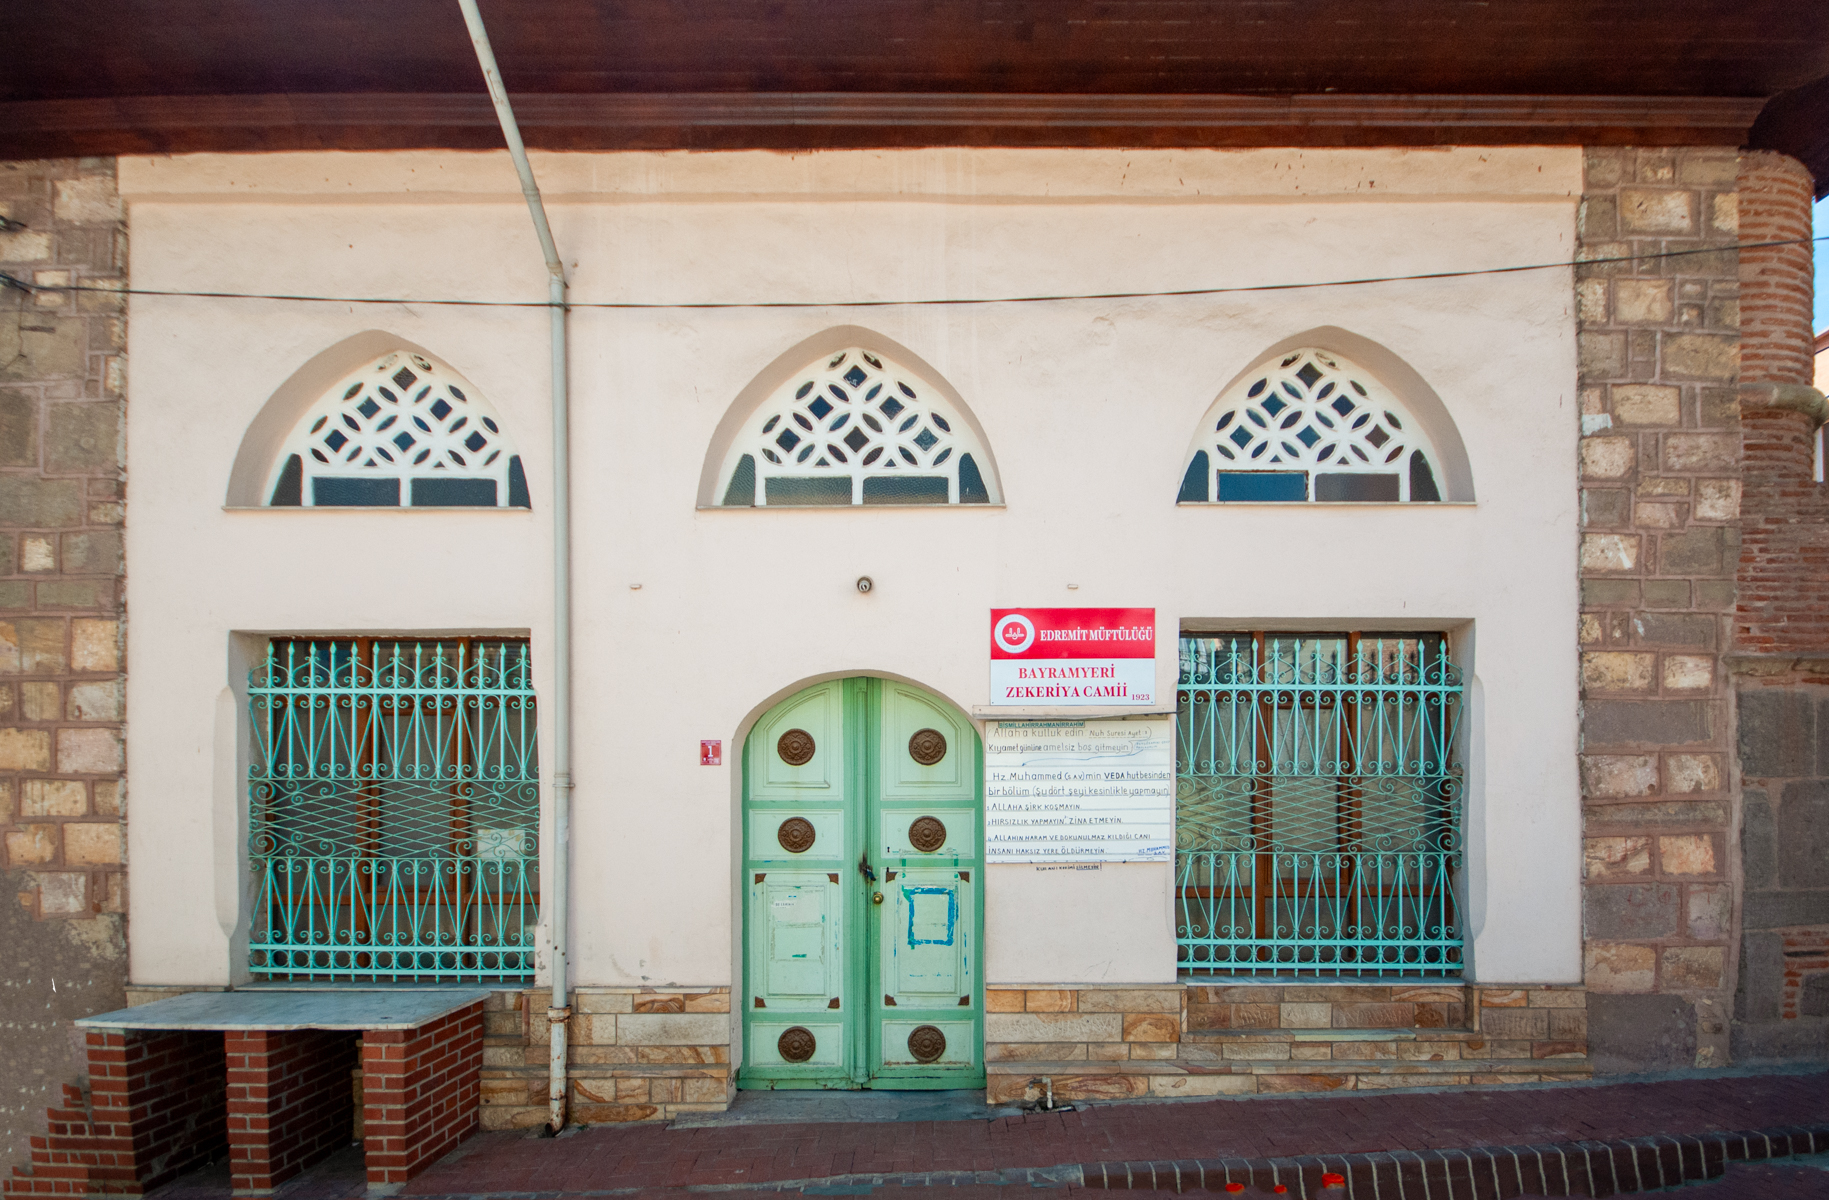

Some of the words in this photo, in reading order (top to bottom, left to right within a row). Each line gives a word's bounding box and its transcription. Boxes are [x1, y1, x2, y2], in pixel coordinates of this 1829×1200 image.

[1040, 627, 1088, 642] EDREMİT
[1089, 626, 1153, 641] MÜFTÜLÜĞÜ
[1018, 664, 1116, 679] BAYRAMYERİ
[1006, 683, 1081, 698] ZEKERİYA
[1083, 682, 1128, 697] CAMİİ
[1031, 728, 1062, 738] kulluk
[707, 745, 714, 758] 1
[1009, 771, 1062, 781] Muhammed
[1104, 772, 1125, 780] VEDA
[988, 786, 1000, 796] bir
[1088, 786, 1128, 795] kesinlikle
[991, 818, 1029, 826] HIRSIZLIK
[1069, 816, 1088, 825] ZİNA
